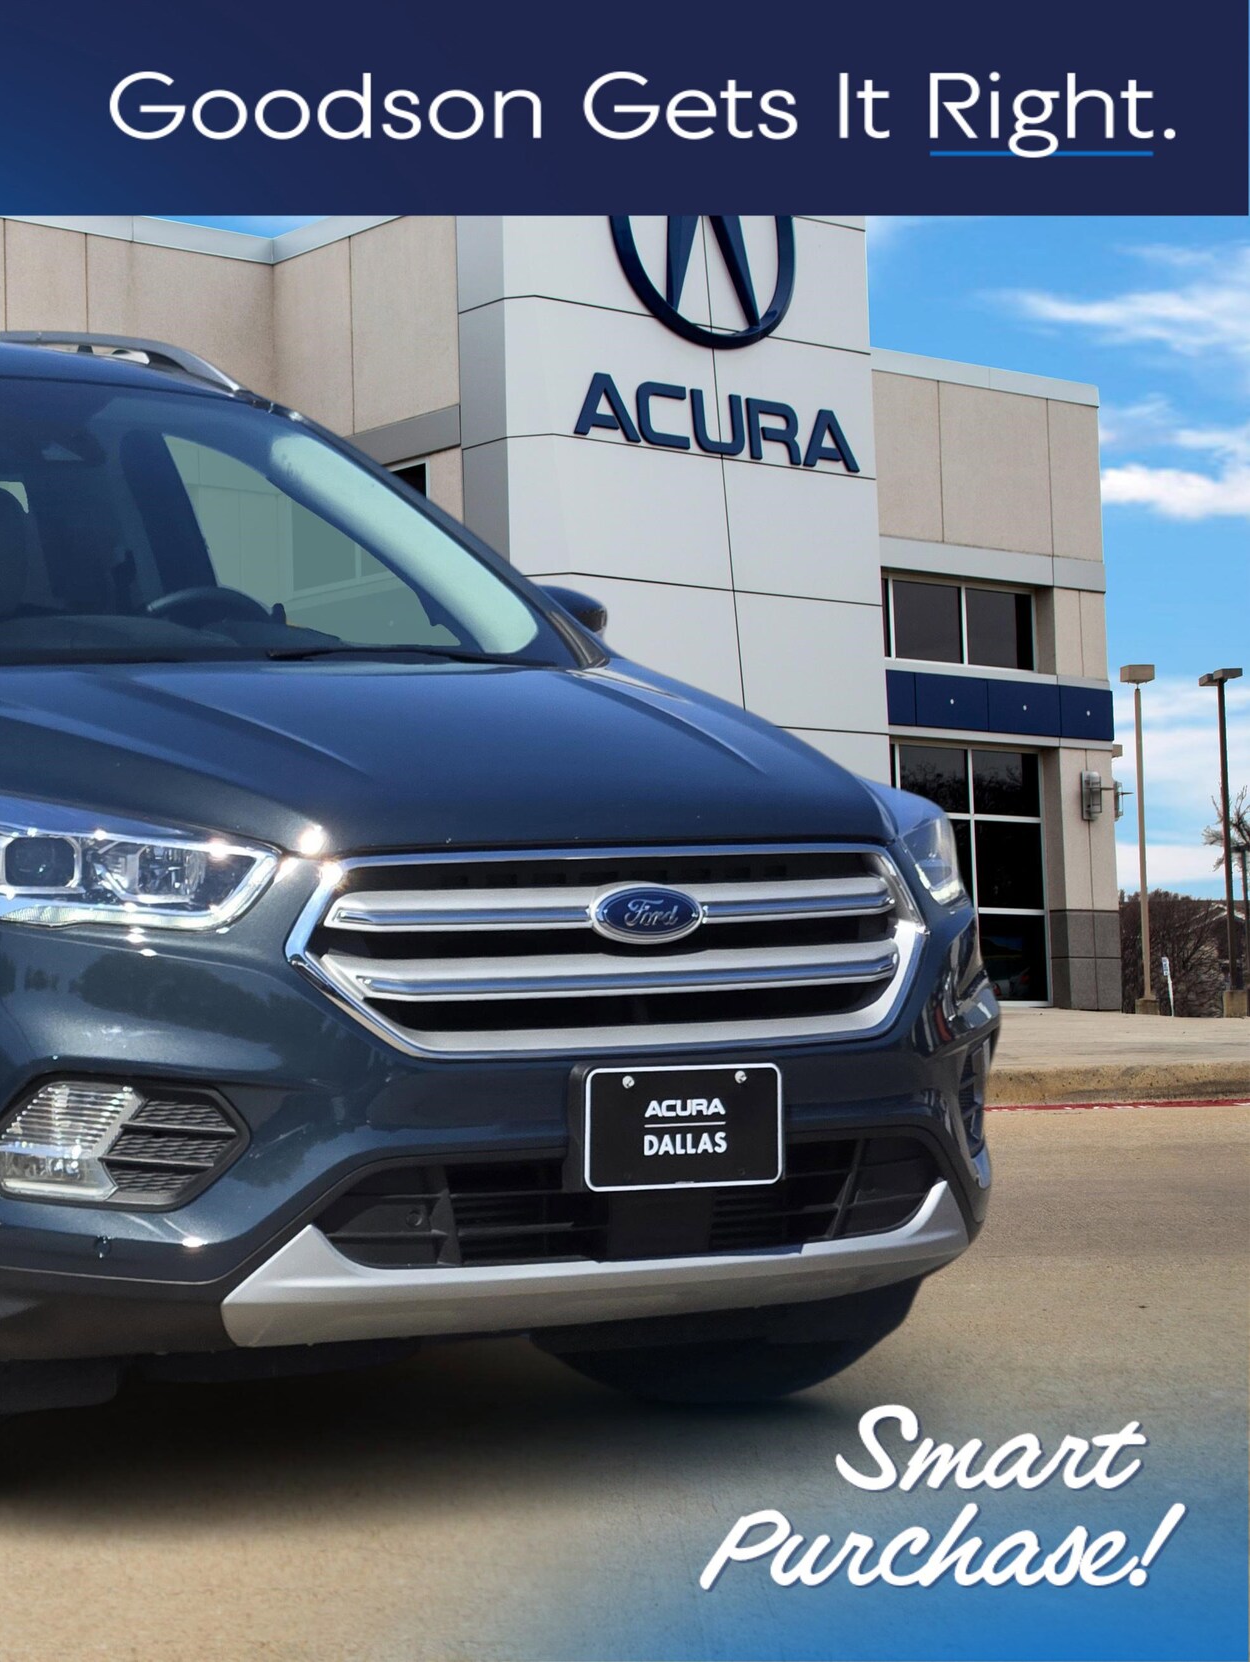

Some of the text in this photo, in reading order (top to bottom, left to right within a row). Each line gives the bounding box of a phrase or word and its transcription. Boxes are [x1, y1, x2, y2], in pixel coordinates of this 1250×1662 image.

[573, 372, 860, 473] ACURA
[624, 899, 679, 927] Ford
[644, 1097, 726, 1118] ACURA
[643, 1131, 728, 1156] DALLAS
